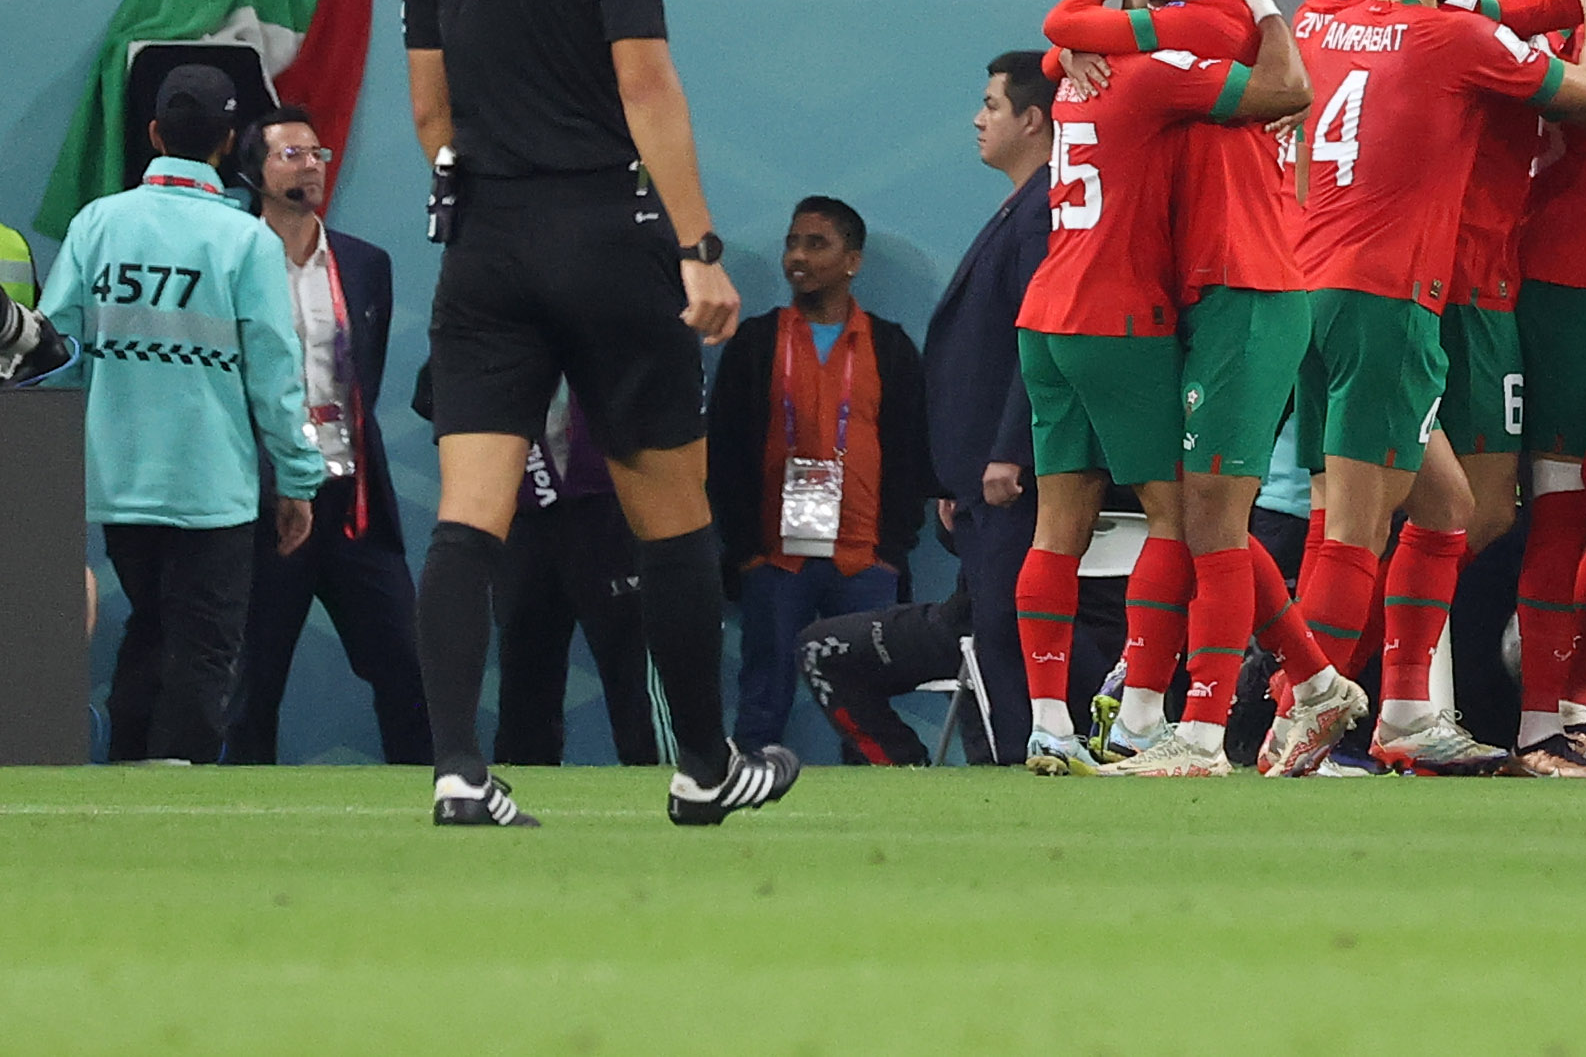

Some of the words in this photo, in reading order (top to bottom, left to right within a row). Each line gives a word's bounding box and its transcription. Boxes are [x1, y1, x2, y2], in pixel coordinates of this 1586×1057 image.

[1321, 21, 1408, 52] AMRABAT
[1311, 69, 1370, 187] 4
[92, 262, 201, 309] 4577
[1503, 373, 1525, 435] 6
